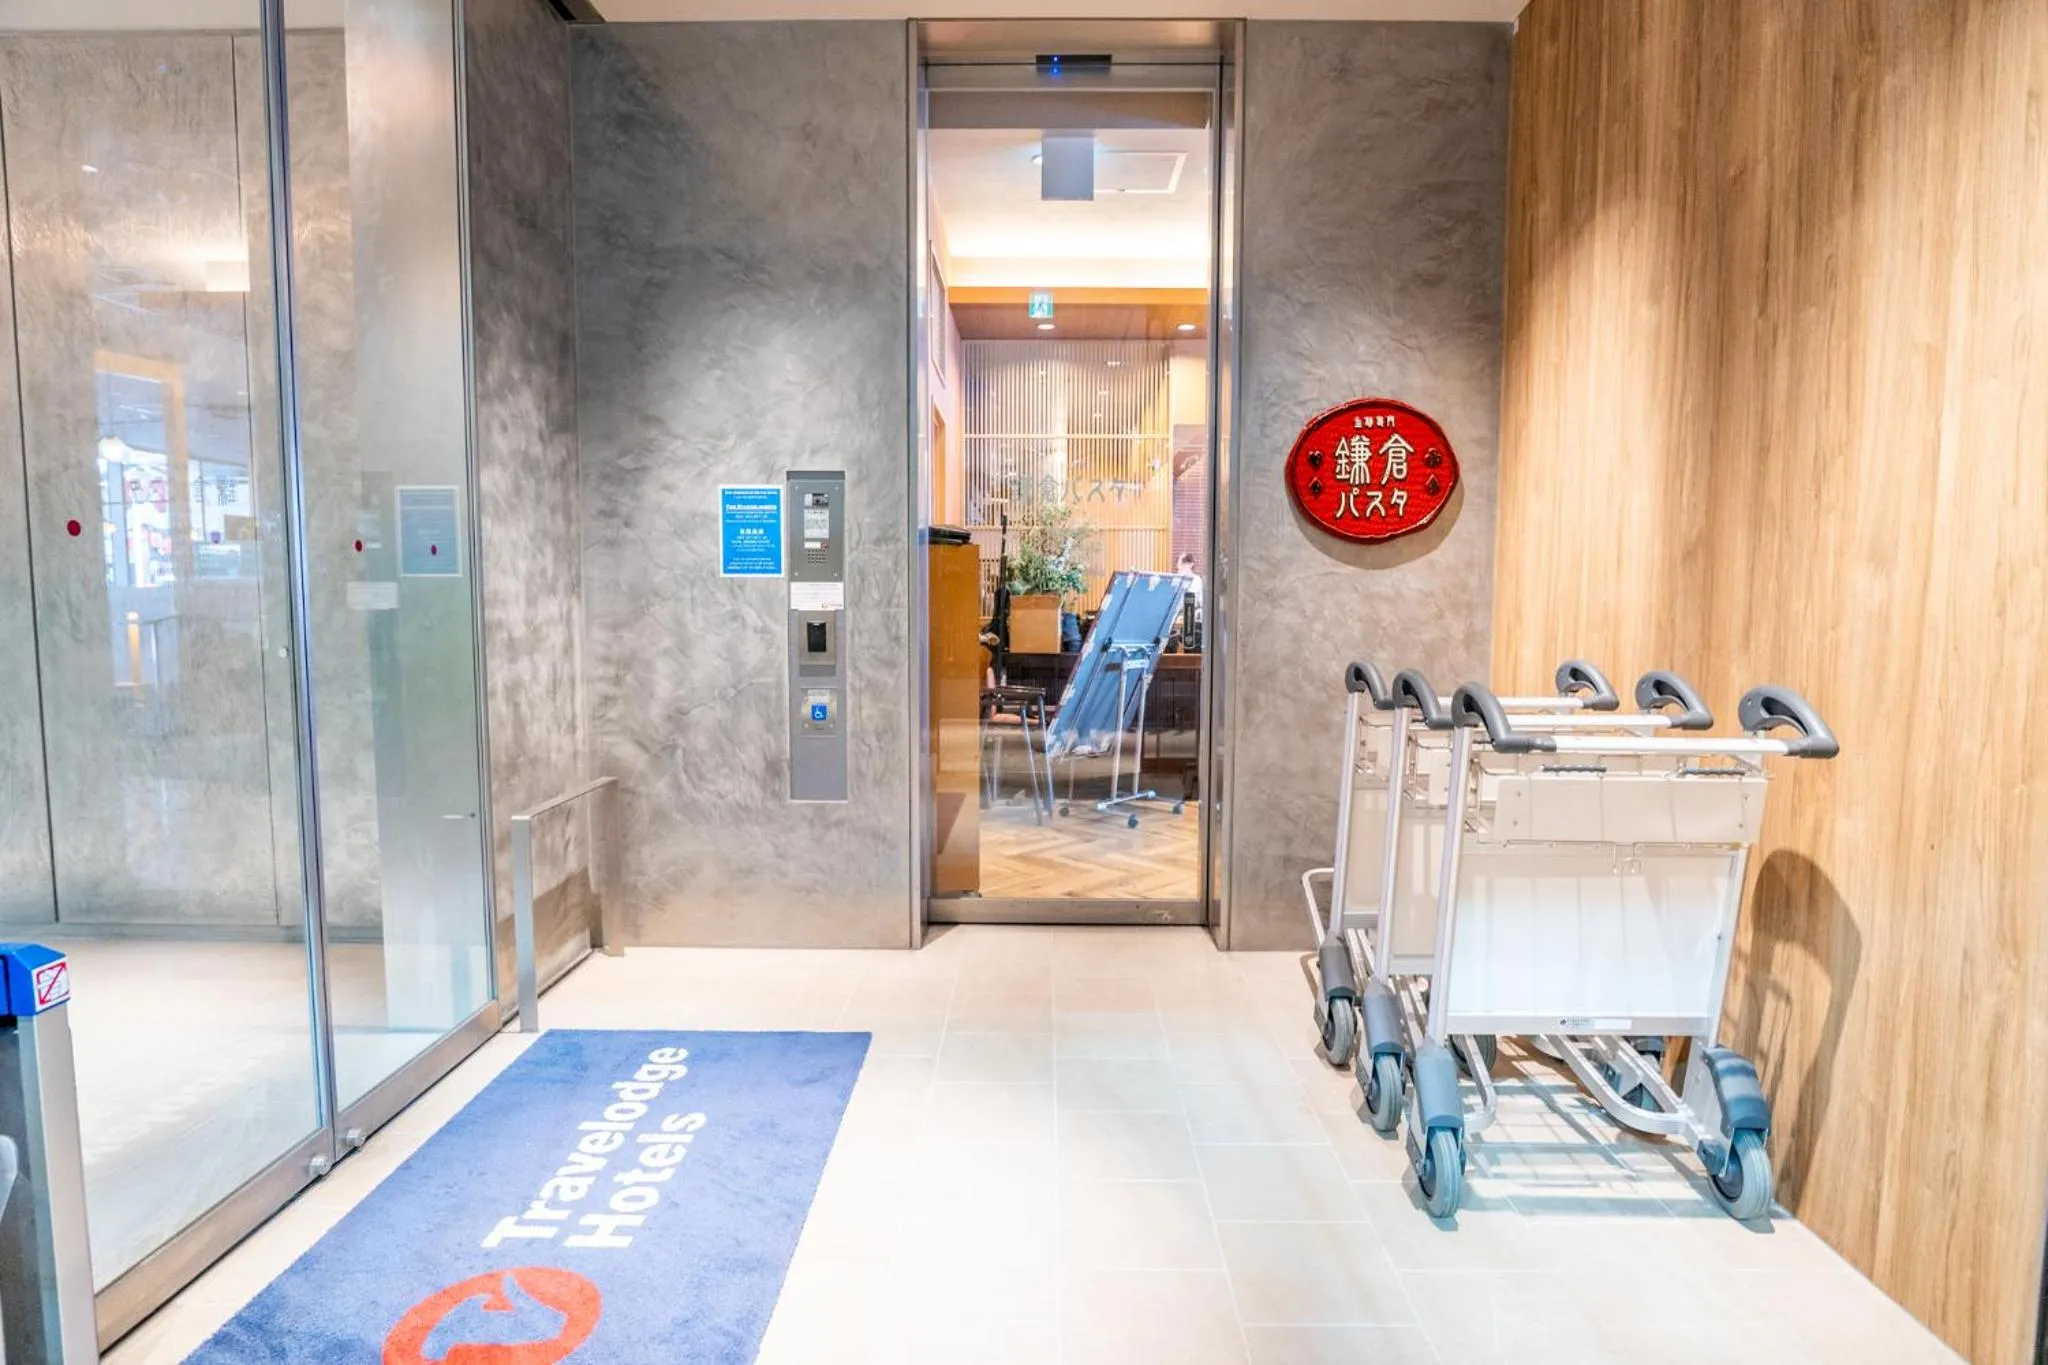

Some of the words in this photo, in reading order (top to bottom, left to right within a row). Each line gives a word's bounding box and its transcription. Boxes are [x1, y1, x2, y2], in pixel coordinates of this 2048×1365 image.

[1335, 432, 1415, 486] 鎌倉
[1014, 474, 1128, 503] 倉パスタ
[1335, 488, 1409, 519] パスタ
[480, 1045, 689, 1248] Travelodge
[563, 1110, 708, 1249] Hotels
